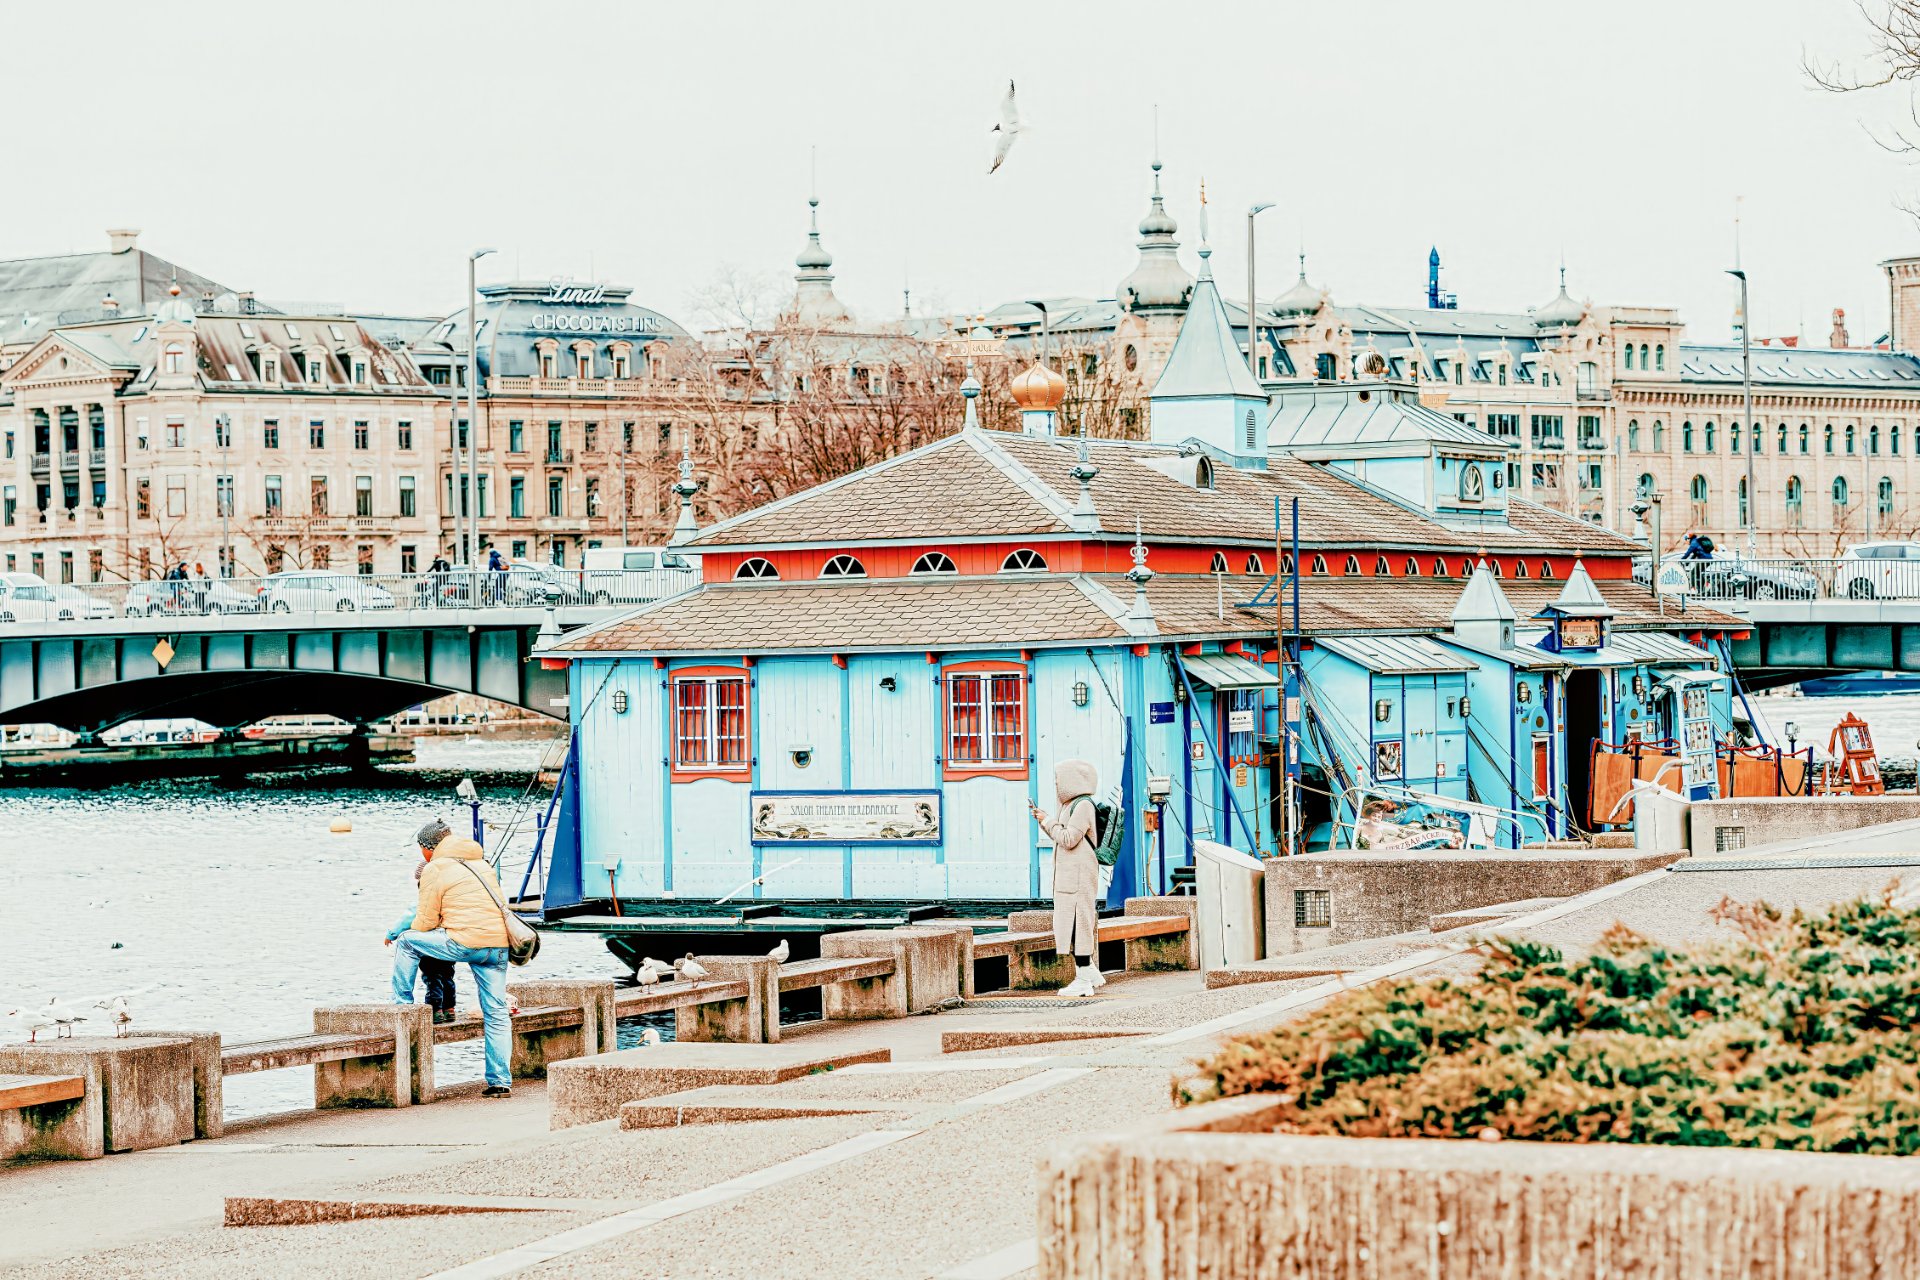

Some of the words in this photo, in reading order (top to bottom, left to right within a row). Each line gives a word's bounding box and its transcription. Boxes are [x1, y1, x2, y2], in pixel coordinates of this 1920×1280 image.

[542, 277, 606, 304] Lindt
[531, 313, 626, 332] CHOCOLATS
[790, 805, 814, 815] SALON
[816, 805, 846, 815] THEATER
